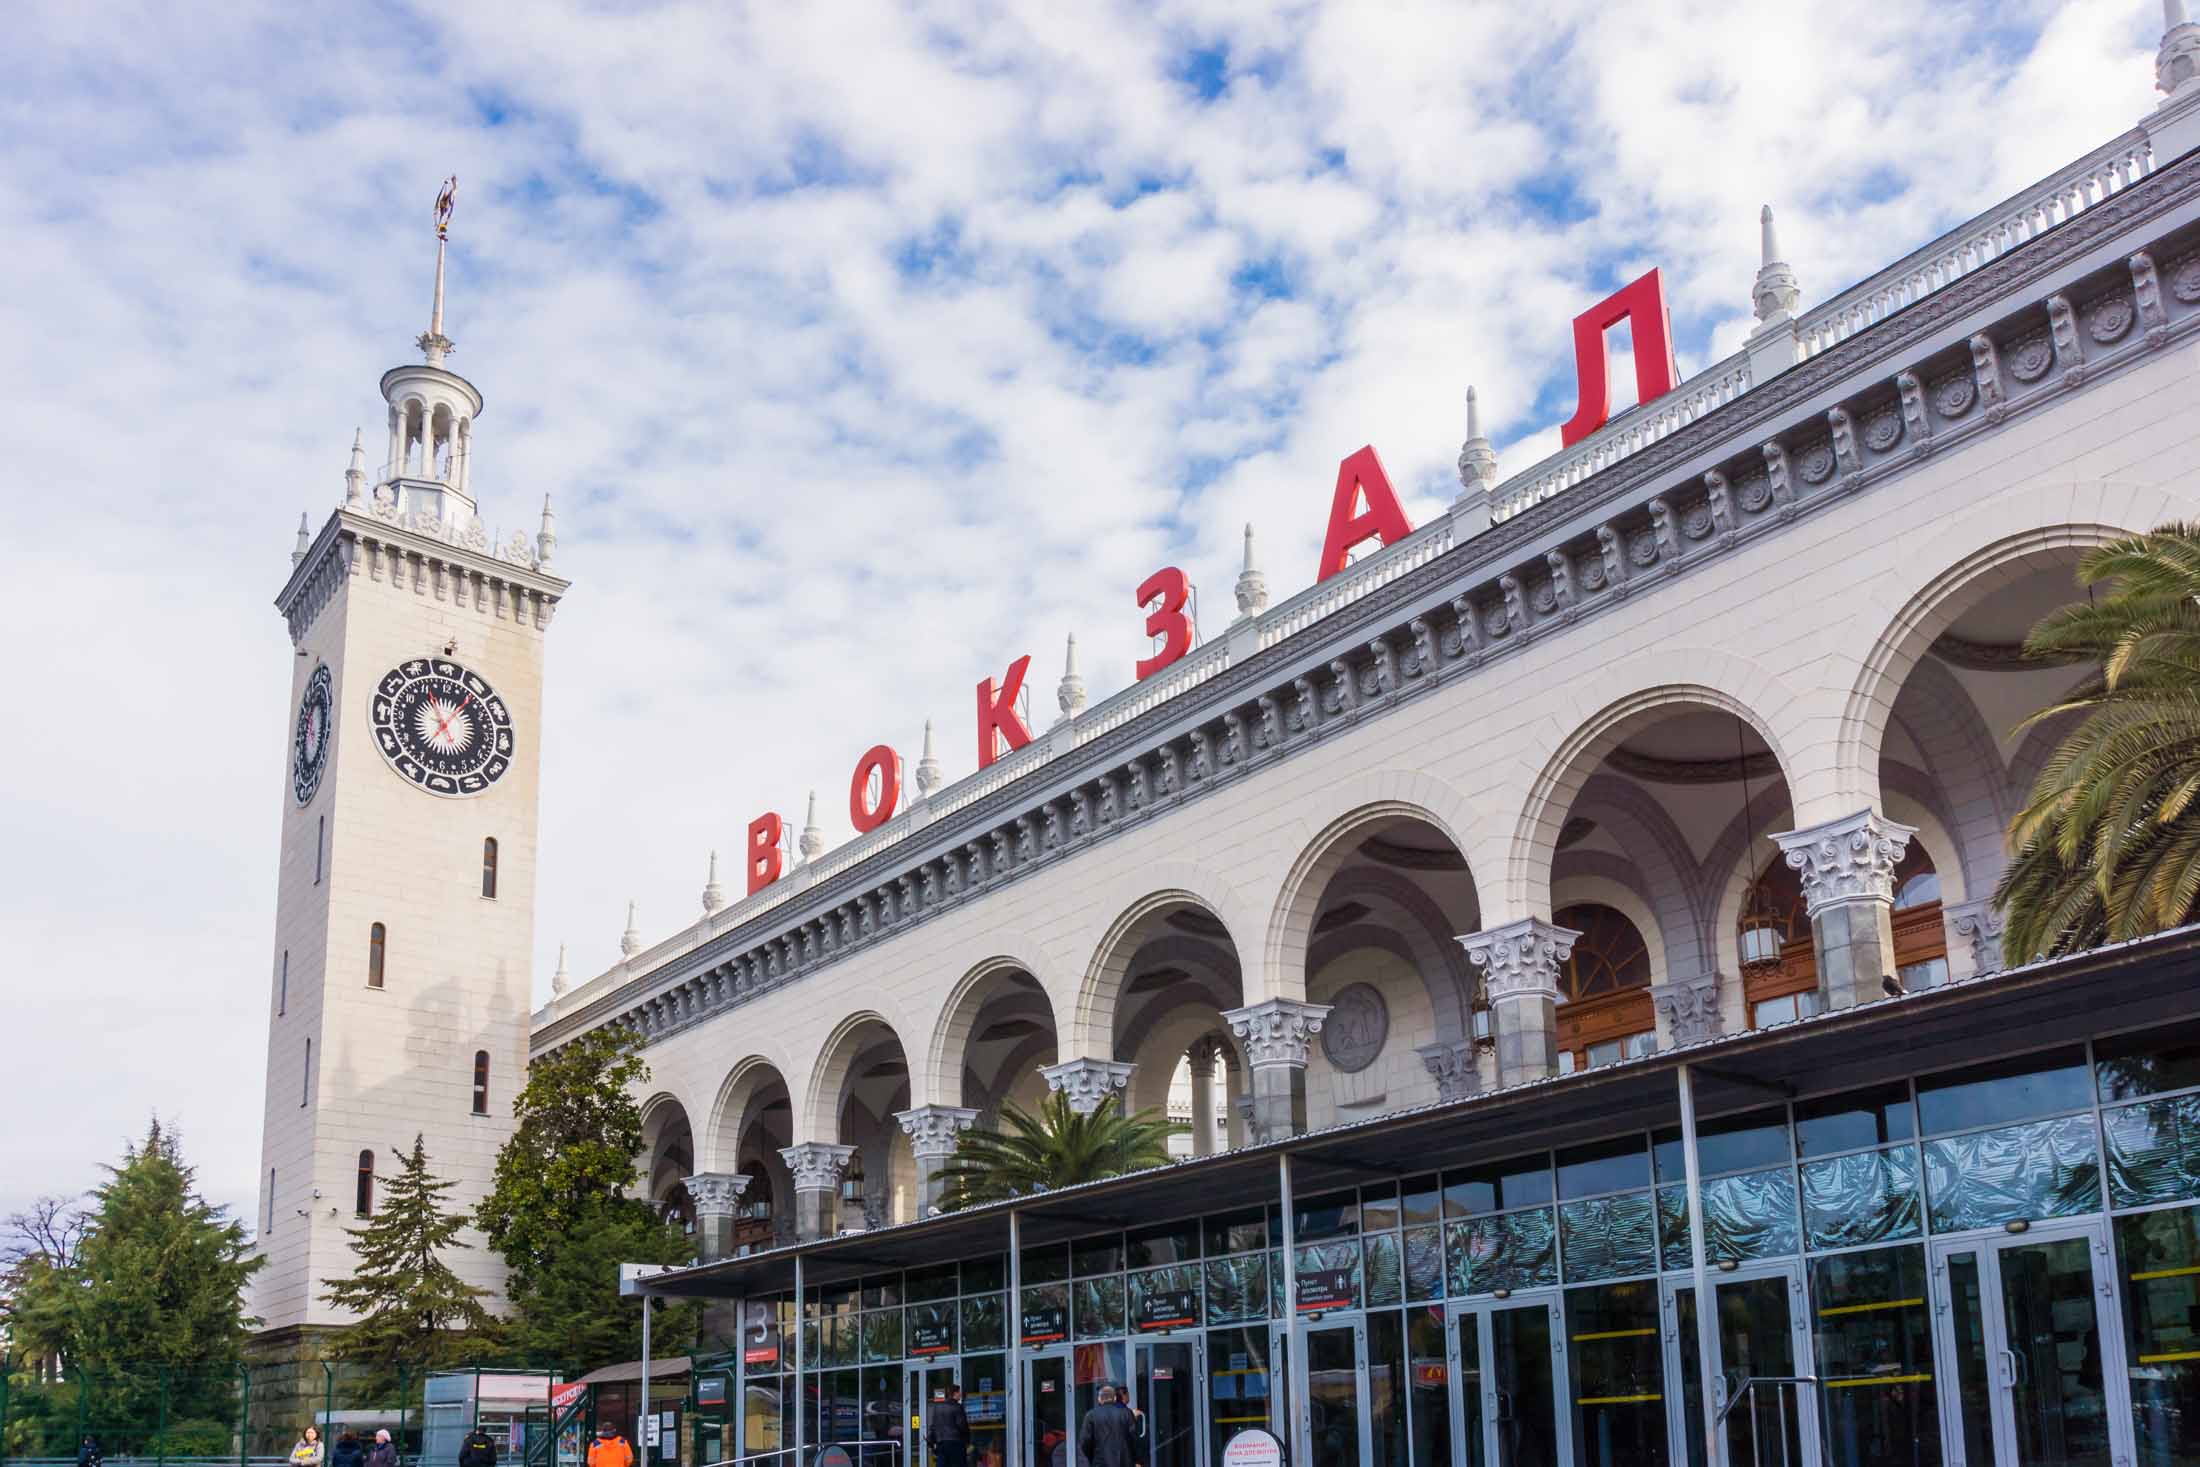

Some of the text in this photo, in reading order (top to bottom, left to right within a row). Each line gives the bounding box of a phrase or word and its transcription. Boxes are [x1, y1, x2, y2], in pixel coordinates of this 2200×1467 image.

[748, 267, 1675, 896] ВОКЗАЛ
[421, 684, 430, 694] 11
[443, 684, 452, 694] 12
[406, 694, 415, 704] 10
[755, 1302, 768, 1344] 3
